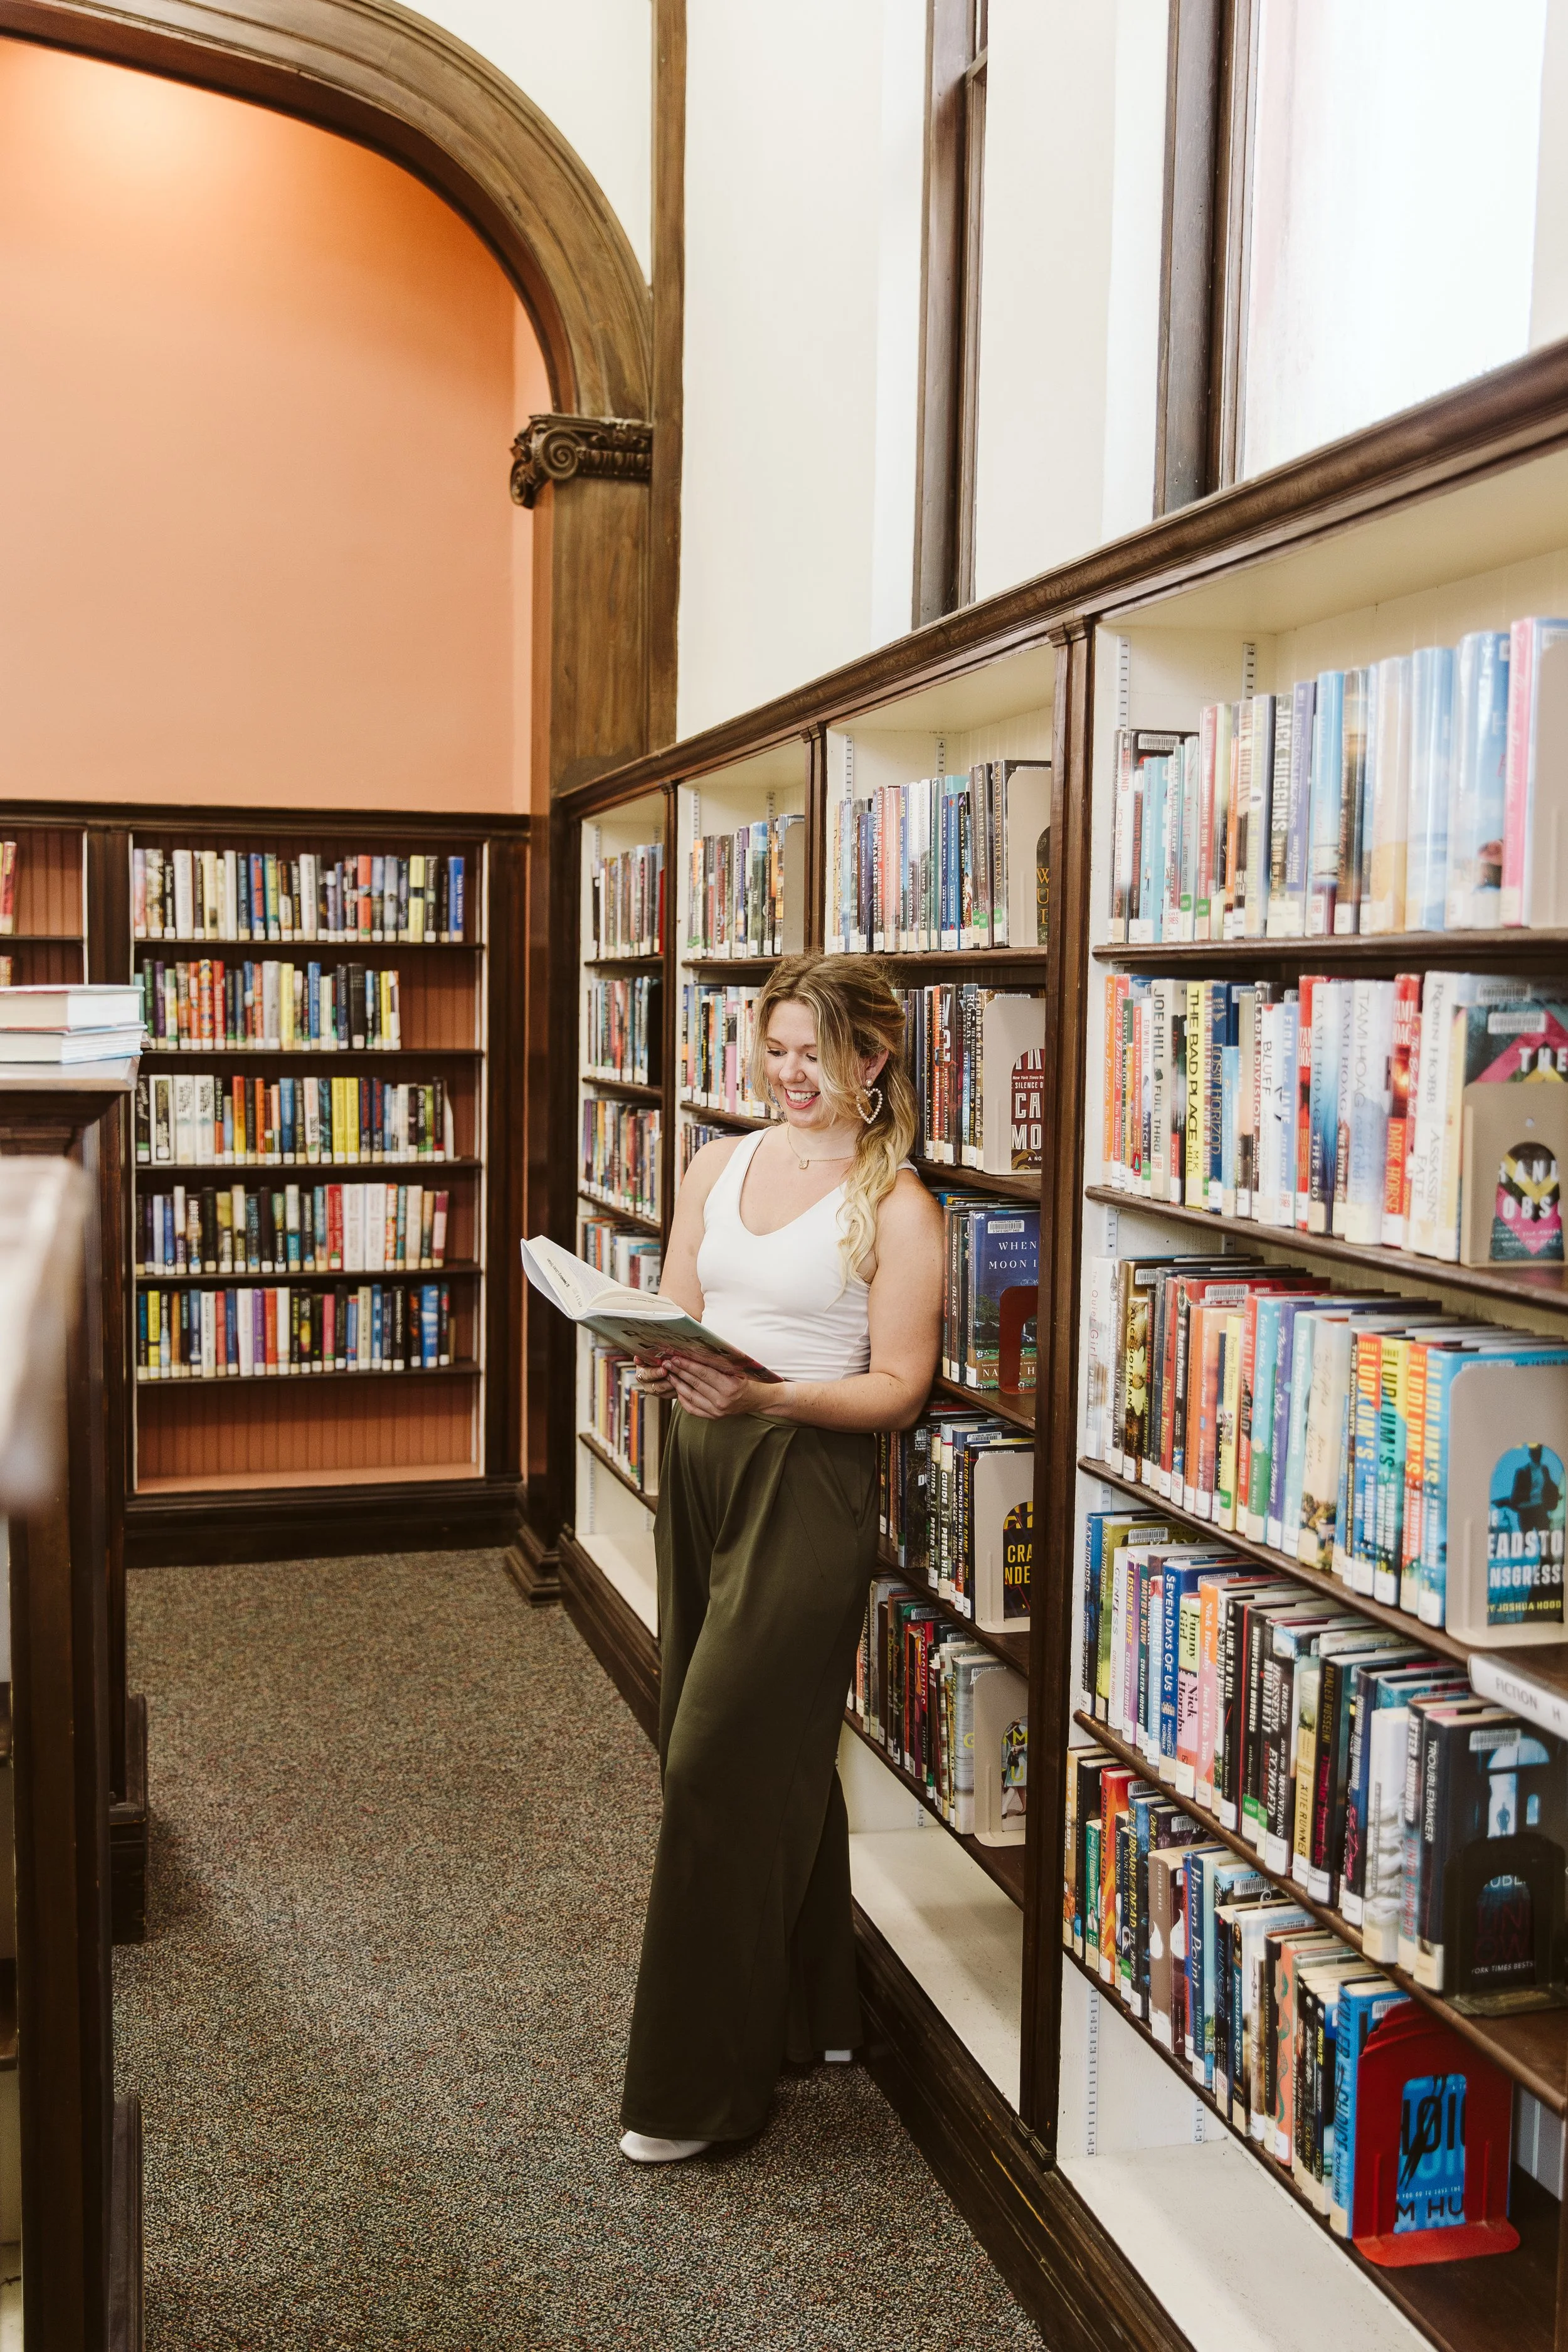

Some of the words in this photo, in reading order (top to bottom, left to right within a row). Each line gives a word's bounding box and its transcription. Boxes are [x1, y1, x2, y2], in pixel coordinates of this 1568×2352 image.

[1275, 706, 1291, 751] JACK
[1272, 757, 1290, 832] HIGGINS
[1153, 988, 1165, 1022] JOE
[1190, 990, 1199, 1029] THE
[1316, 995, 1324, 1052] TAMI
[1343, 997, 1352, 1051] TAMI
[1356, 990, 1369, 1040] TAMI
[1433, 983, 1444, 1040] ROBIN
[1153, 1025, 1164, 1062] HILL
[1189, 1034, 1199, 1076] BAD
[1519, 1047, 1567, 1073] THE
[1263, 1040, 1272, 1096] BLUFF
[1340, 1056, 1349, 1112] HOAG
[1354, 1044, 1367, 1107] HOAG
[1428, 1047, 1439, 1104] HOBB
[1153, 1085, 1162, 1114] FULL
[1188, 1081, 1198, 1141] PLACE
[1313, 1061, 1322, 1125] HOAG
[1387, 1124, 1403, 1165] DARK
[1385, 1168, 1402, 1214] HORSE
[988, 1260, 1027, 1269] MOON
[999, 1242, 1037, 1250] WHEN
[1297, 1328, 1307, 1353] The
[1291, 1357, 1306, 1456] Displacements
[1357, 1353, 1377, 1461] LUDLUM'S
[1379, 1357, 1399, 1468] LUDLUM'S
[1406, 1360, 1424, 1475] LUDLUM'S
[1424, 1364, 1443, 1484] LUDLUM'S
[1161, 1417, 1169, 1454] Hogan
[1126, 1571, 1134, 1611] LOSING
[1165, 1574, 1175, 1611] SEVEN
[1497, 1601, 1534, 1612] JOSHUA
[1537, 1601, 1561, 1610] HOOD
[1165, 1614, 1174, 1648] DAYS
[1179, 1609, 1188, 1640] Girl
[1187, 1612, 1200, 1661] Funny
[1204, 1601, 1212, 1628] Nick
[1165, 1652, 1174, 1669] OF
[1203, 1631, 1212, 1673] Hornby
[1226, 1658, 1233, 1673] TO
[1163, 1672, 1173, 1692] US
[1187, 1682, 1198, 1717] Nick
[1202, 1684, 1210, 1703] Just
[1225, 1677, 1233, 1698] KILL
[1495, 1677, 1539, 1712] FICTION
[1553, 1707, 1561, 1722] H
[1177, 1680, 1187, 1737] Hornby
[1248, 1688, 1257, 1734] MURDERS
[1201, 1734, 1209, 1761] You
[1409, 1715, 1421, 1752] AFTER
[1268, 1749, 1278, 1817] ECHOED
[1405, 1757, 1419, 1822] SUNDOWN
[1425, 1740, 1436, 1842] TROUBLEMAKER
[1298, 1808, 1308, 1857] RUNNER
[1406, 1838, 1418, 1876] LINDA
[1190, 1867, 1201, 1928] Haven
[1402, 1880, 1416, 1937] HOWARD
[1190, 1934, 1202, 1988] Point
[1216, 1937, 1225, 2020] HUNGER
[1491, 1963, 1512, 1973] TIMES
[1337, 1991, 1352, 2058] KILLER
[1334, 2087, 1348, 2152] CHOICE
